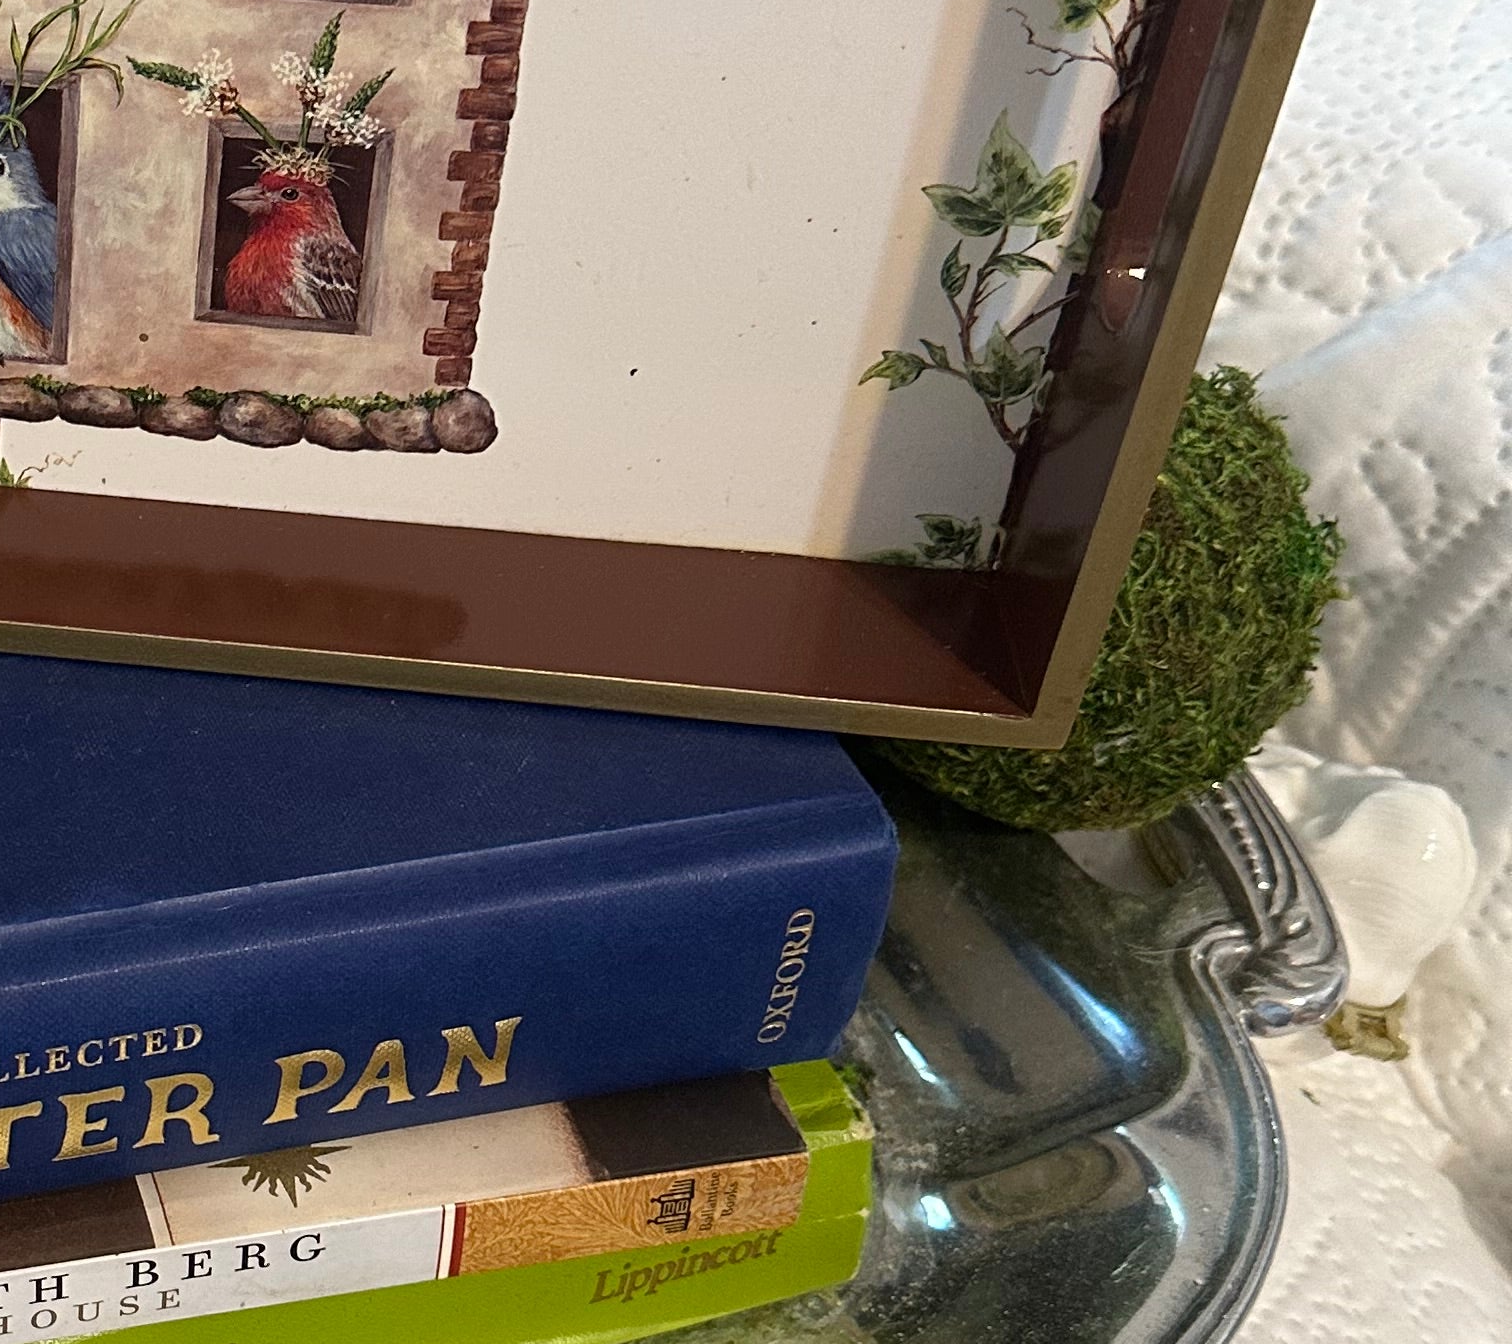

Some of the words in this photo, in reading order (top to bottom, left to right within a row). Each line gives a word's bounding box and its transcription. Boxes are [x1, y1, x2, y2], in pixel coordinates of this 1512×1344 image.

[756, 907, 816, 1045] OXFORD
[262, 1015, 524, 1126] PAN
[698, 1170, 722, 1233] Ballantine
[719, 1180, 738, 1218] Books
[124, 1232, 327, 1290] BERG
[588, 1229, 784, 1305] Lippincott
